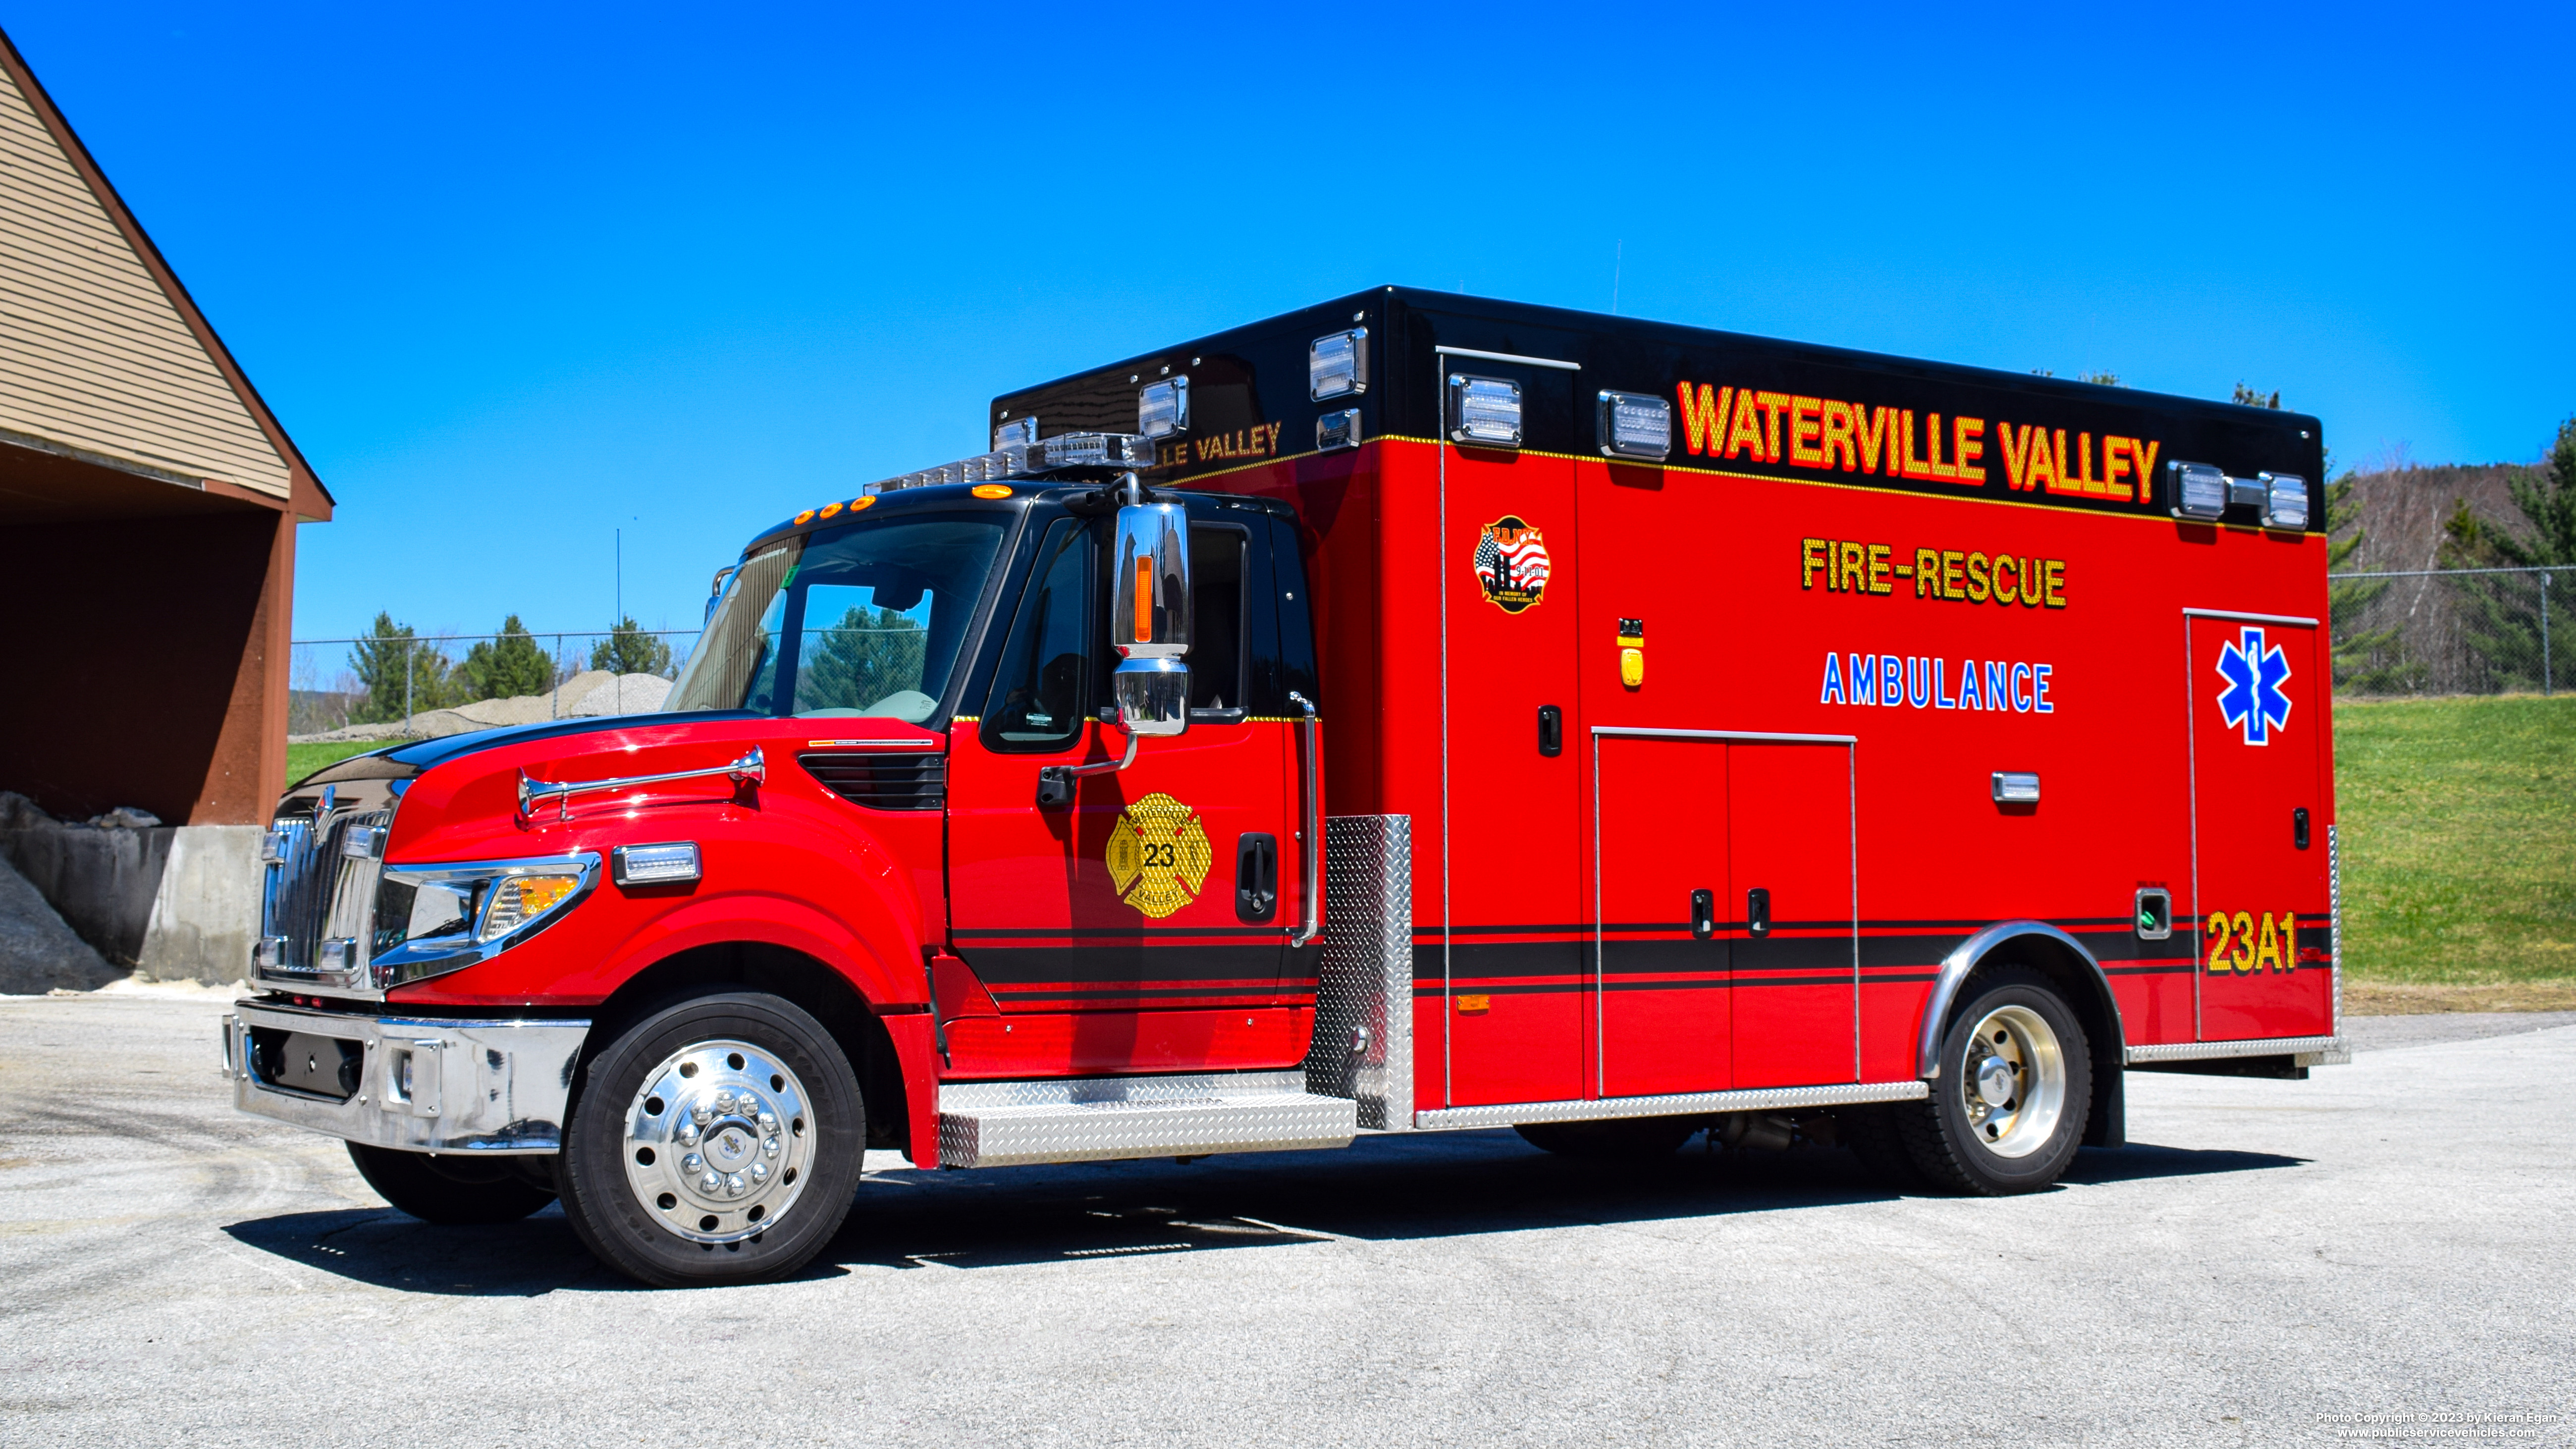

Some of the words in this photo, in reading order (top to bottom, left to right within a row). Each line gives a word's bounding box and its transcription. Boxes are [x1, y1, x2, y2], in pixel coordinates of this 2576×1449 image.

[1195, 421, 1282, 462] VALLEY
[1677, 381, 1986, 486] WATERVILLE
[1997, 421, 2160, 504] VALLEY
[1493, 527, 1534, 545] F.D.N.Y.
[1516, 566, 1544, 577] 9-11-01
[1802, 537, 2067, 608] FIRE-RESCUE
[1821, 651, 2054, 713] AMBULANCE
[1132, 807, 1186, 826] WATERVILLE
[1143, 843, 1175, 867] 23
[1139, 889, 1179, 903] VALLEY
[2206, 910, 2297, 976] 23A1
